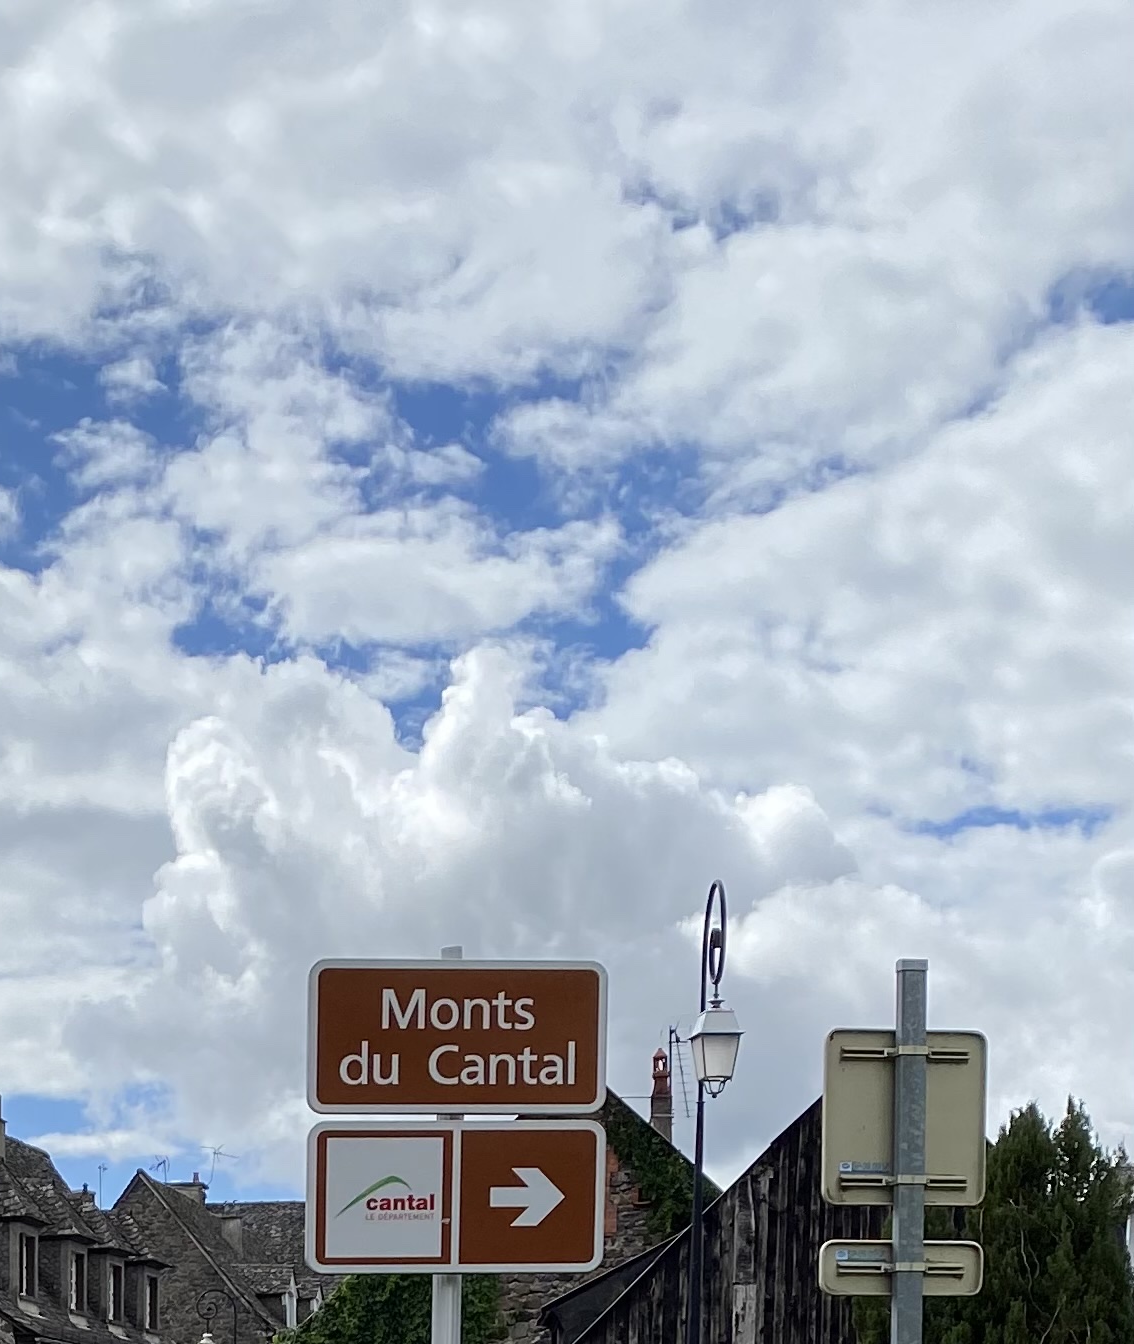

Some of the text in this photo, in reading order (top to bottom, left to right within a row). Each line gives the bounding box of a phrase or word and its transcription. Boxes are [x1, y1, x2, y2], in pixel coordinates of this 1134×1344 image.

[380, 987, 536, 1031] Monts
[338, 1040, 576, 1086] du Cantal
[365, 1211, 435, 1221] LE DÉPARTEMENT
[366, 1193, 435, 1211] cantal
